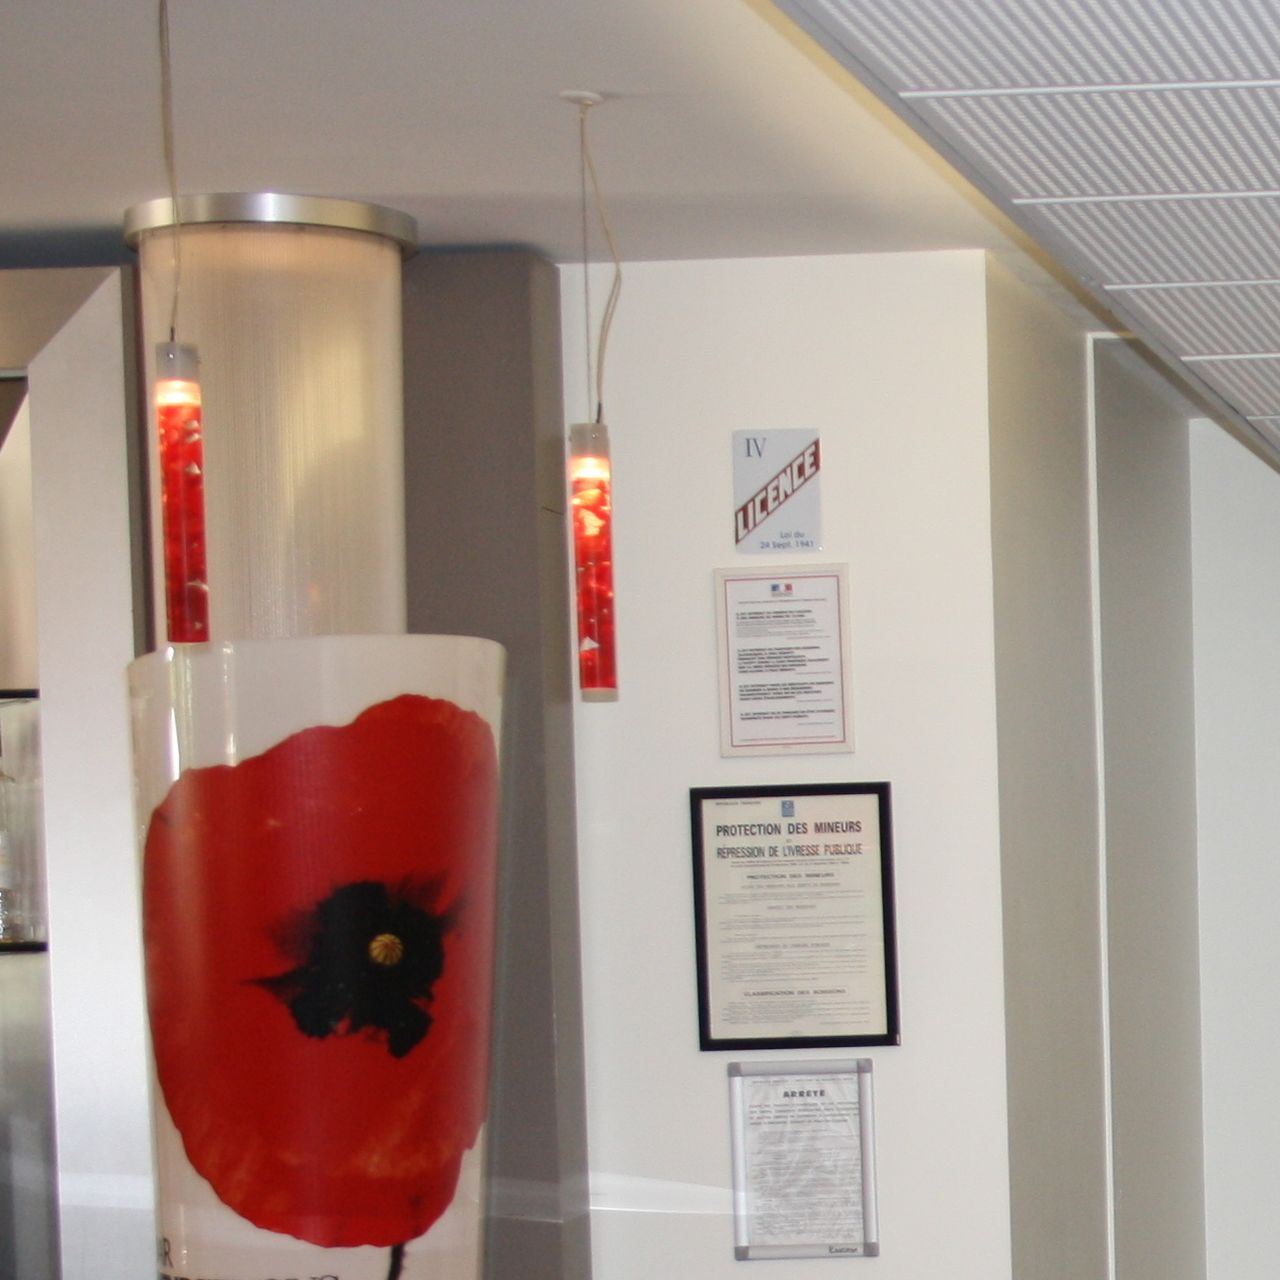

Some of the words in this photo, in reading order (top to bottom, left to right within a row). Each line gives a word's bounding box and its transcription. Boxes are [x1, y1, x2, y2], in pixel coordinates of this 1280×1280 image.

[745, 437, 767, 458] IV
[735, 438, 820, 545] LICENCE
[716, 823, 782, 837] PROTECTION
[787, 822, 808, 835] DES
[814, 820, 862, 834] MINEURS
[768, 845, 779, 858] DE
[824, 843, 863, 857] PUBLIQUE
